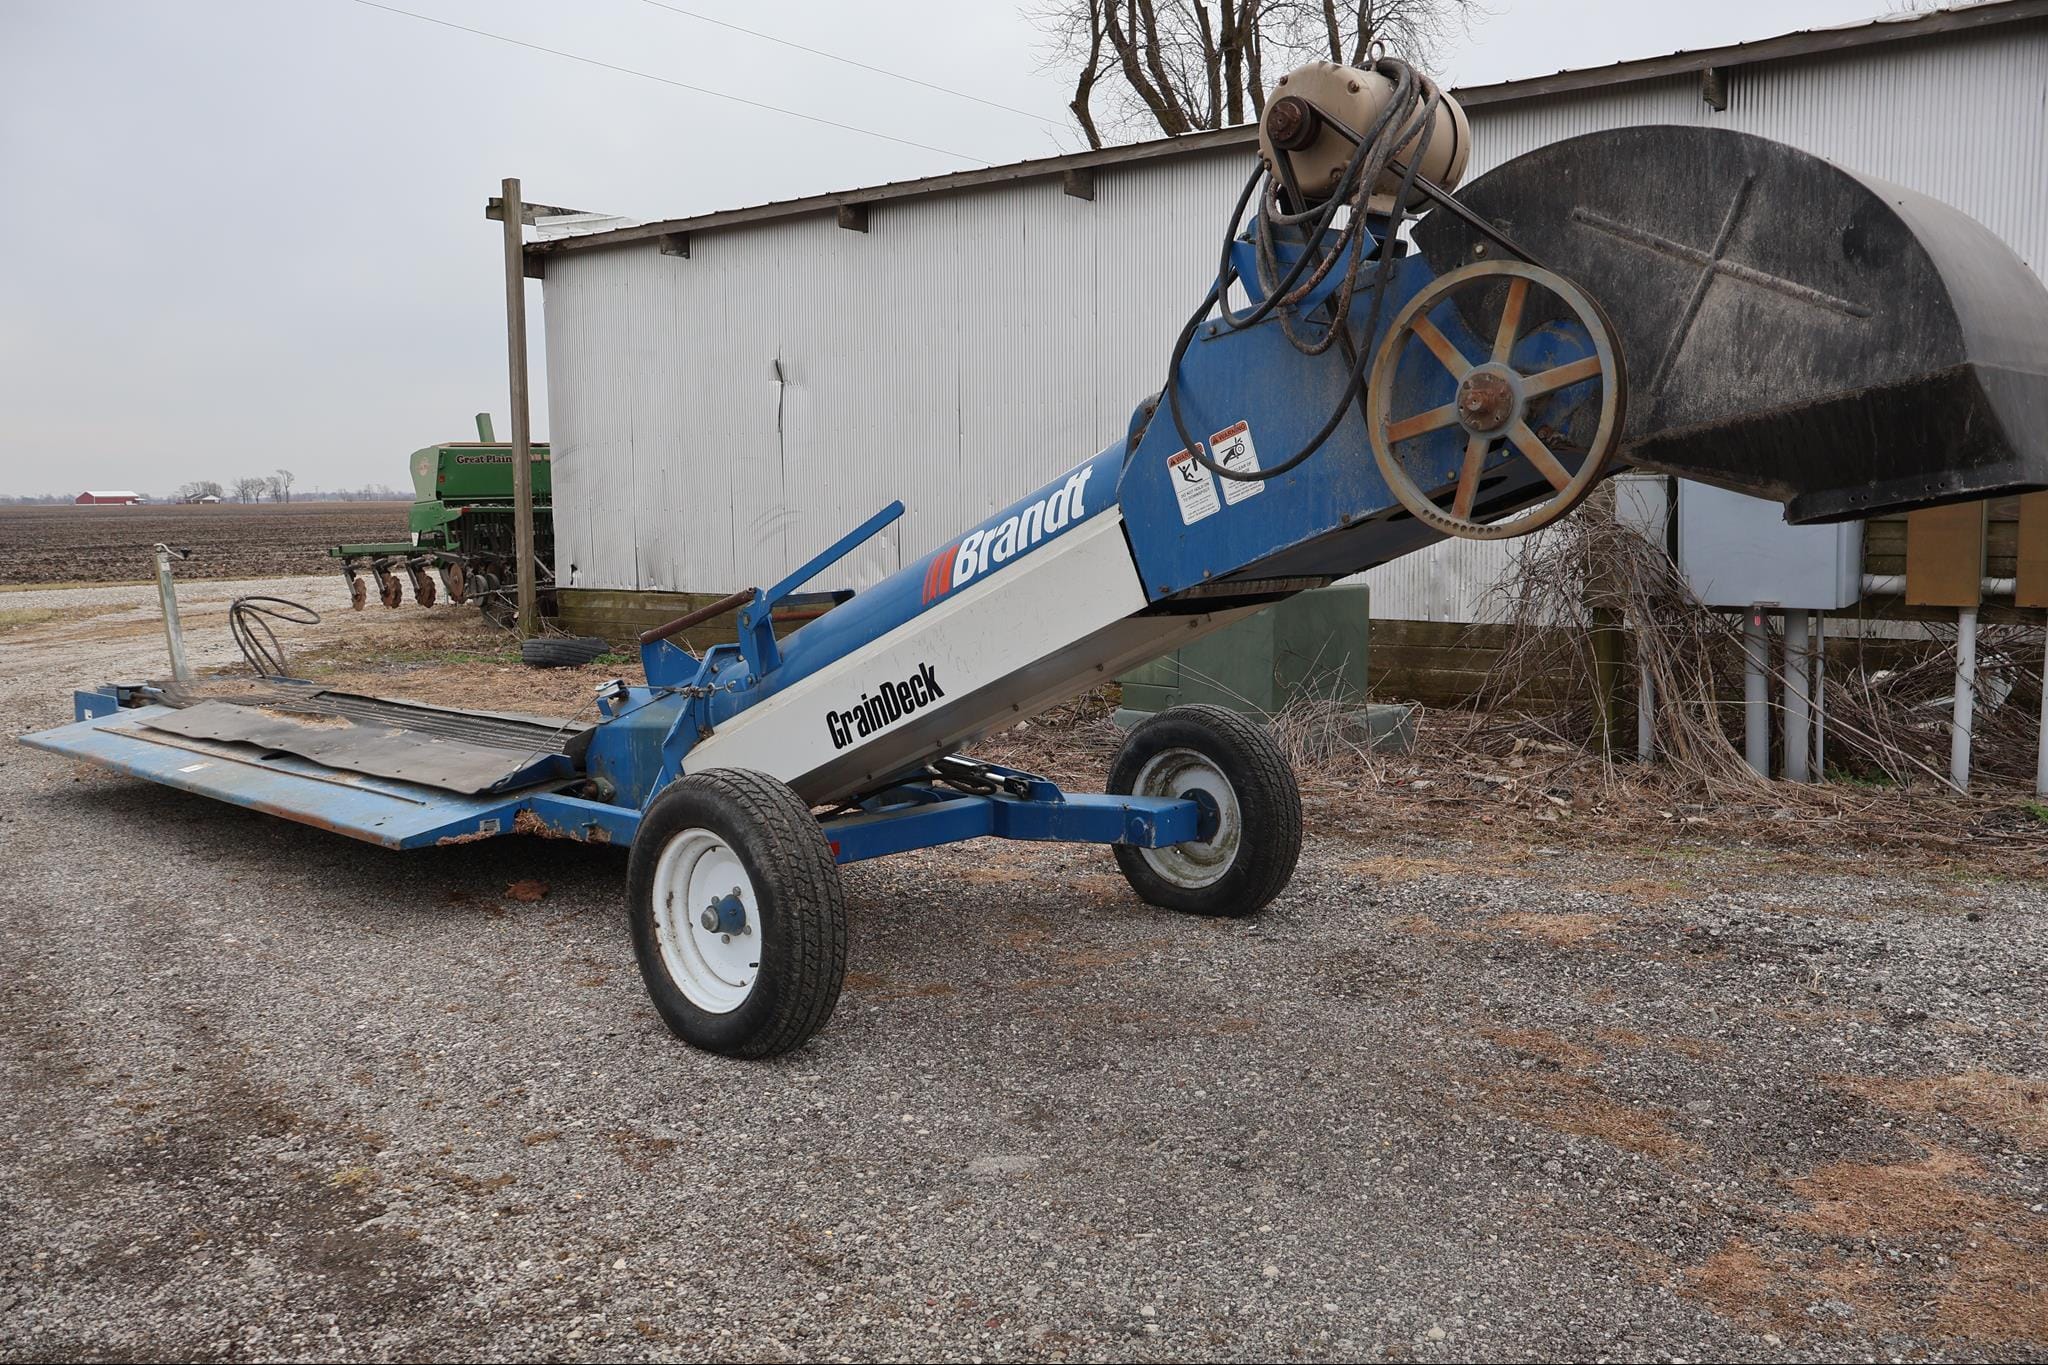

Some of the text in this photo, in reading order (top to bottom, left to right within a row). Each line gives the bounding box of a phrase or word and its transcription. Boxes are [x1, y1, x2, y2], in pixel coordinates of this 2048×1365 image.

[456, 455, 484, 464] Great
[953, 465, 1093, 588] Brandt
[826, 662, 944, 749] GrainDeck
